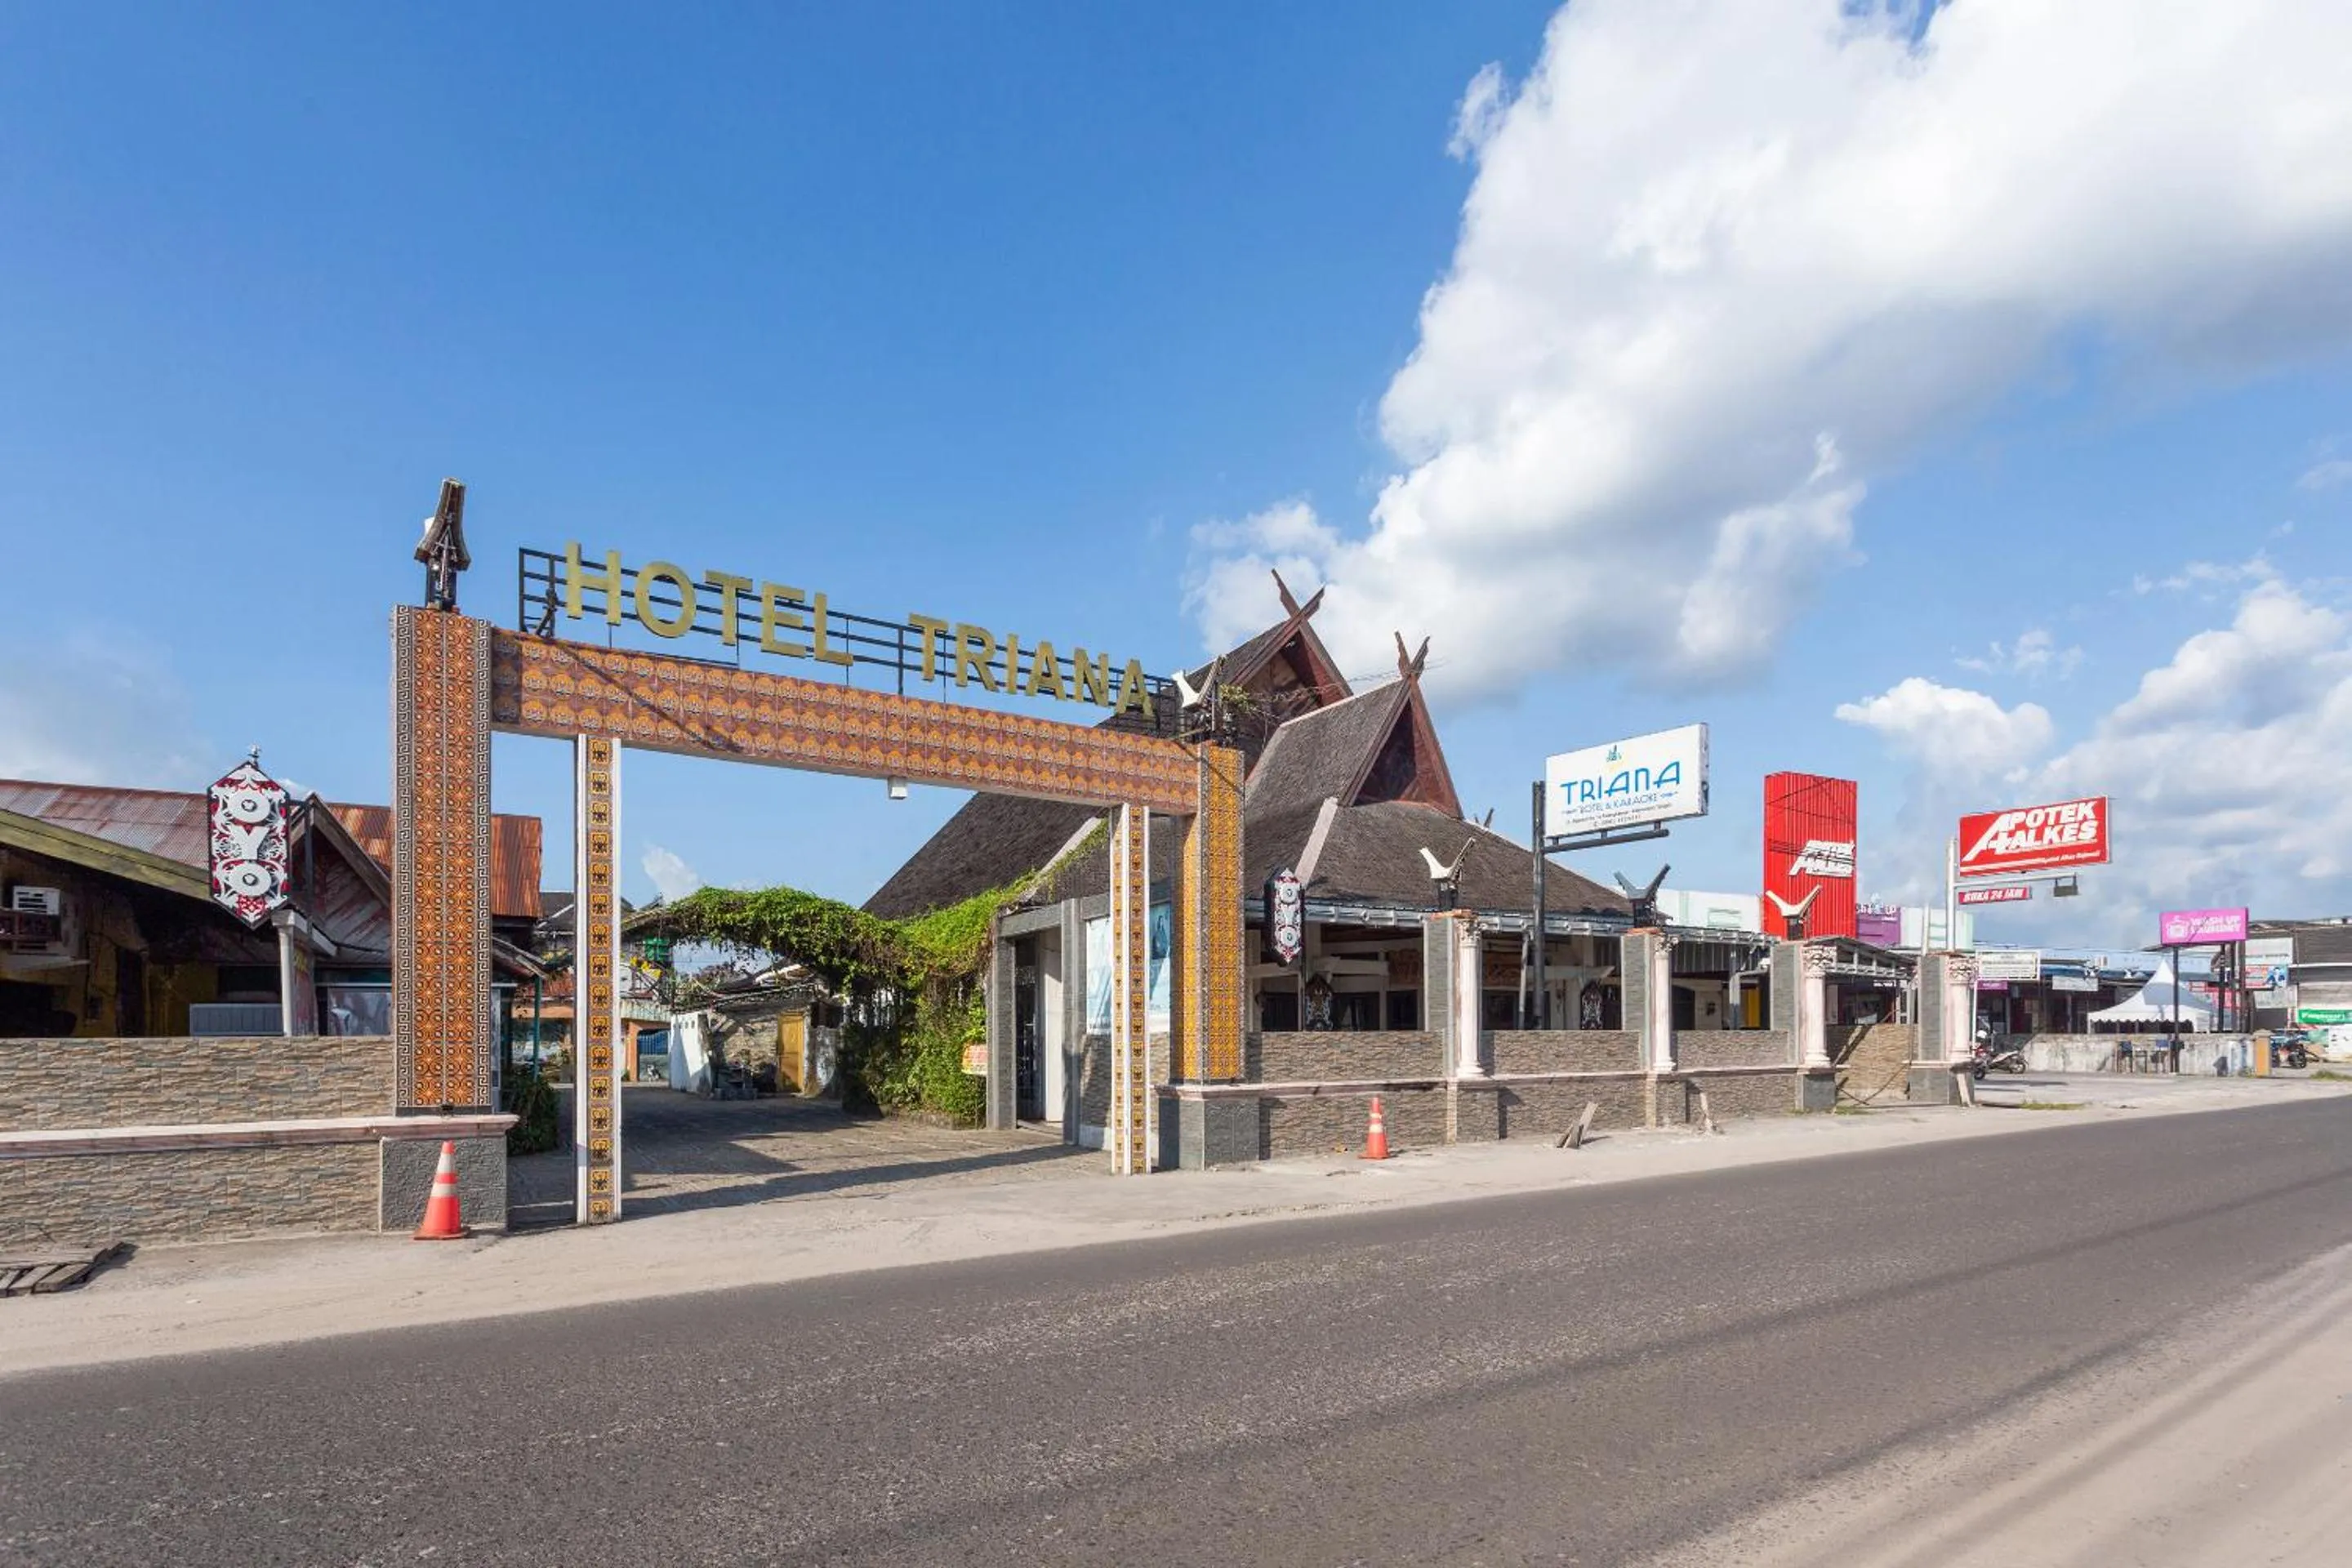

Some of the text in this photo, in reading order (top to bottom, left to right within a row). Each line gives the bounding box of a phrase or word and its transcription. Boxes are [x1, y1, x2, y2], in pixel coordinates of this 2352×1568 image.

[566, 541, 1154, 716] HOTEL TRIANA
[1560, 761, 1680, 805] TRIANA
[226, 790, 271, 897] OYO
[1962, 801, 2098, 862] APOTEK
